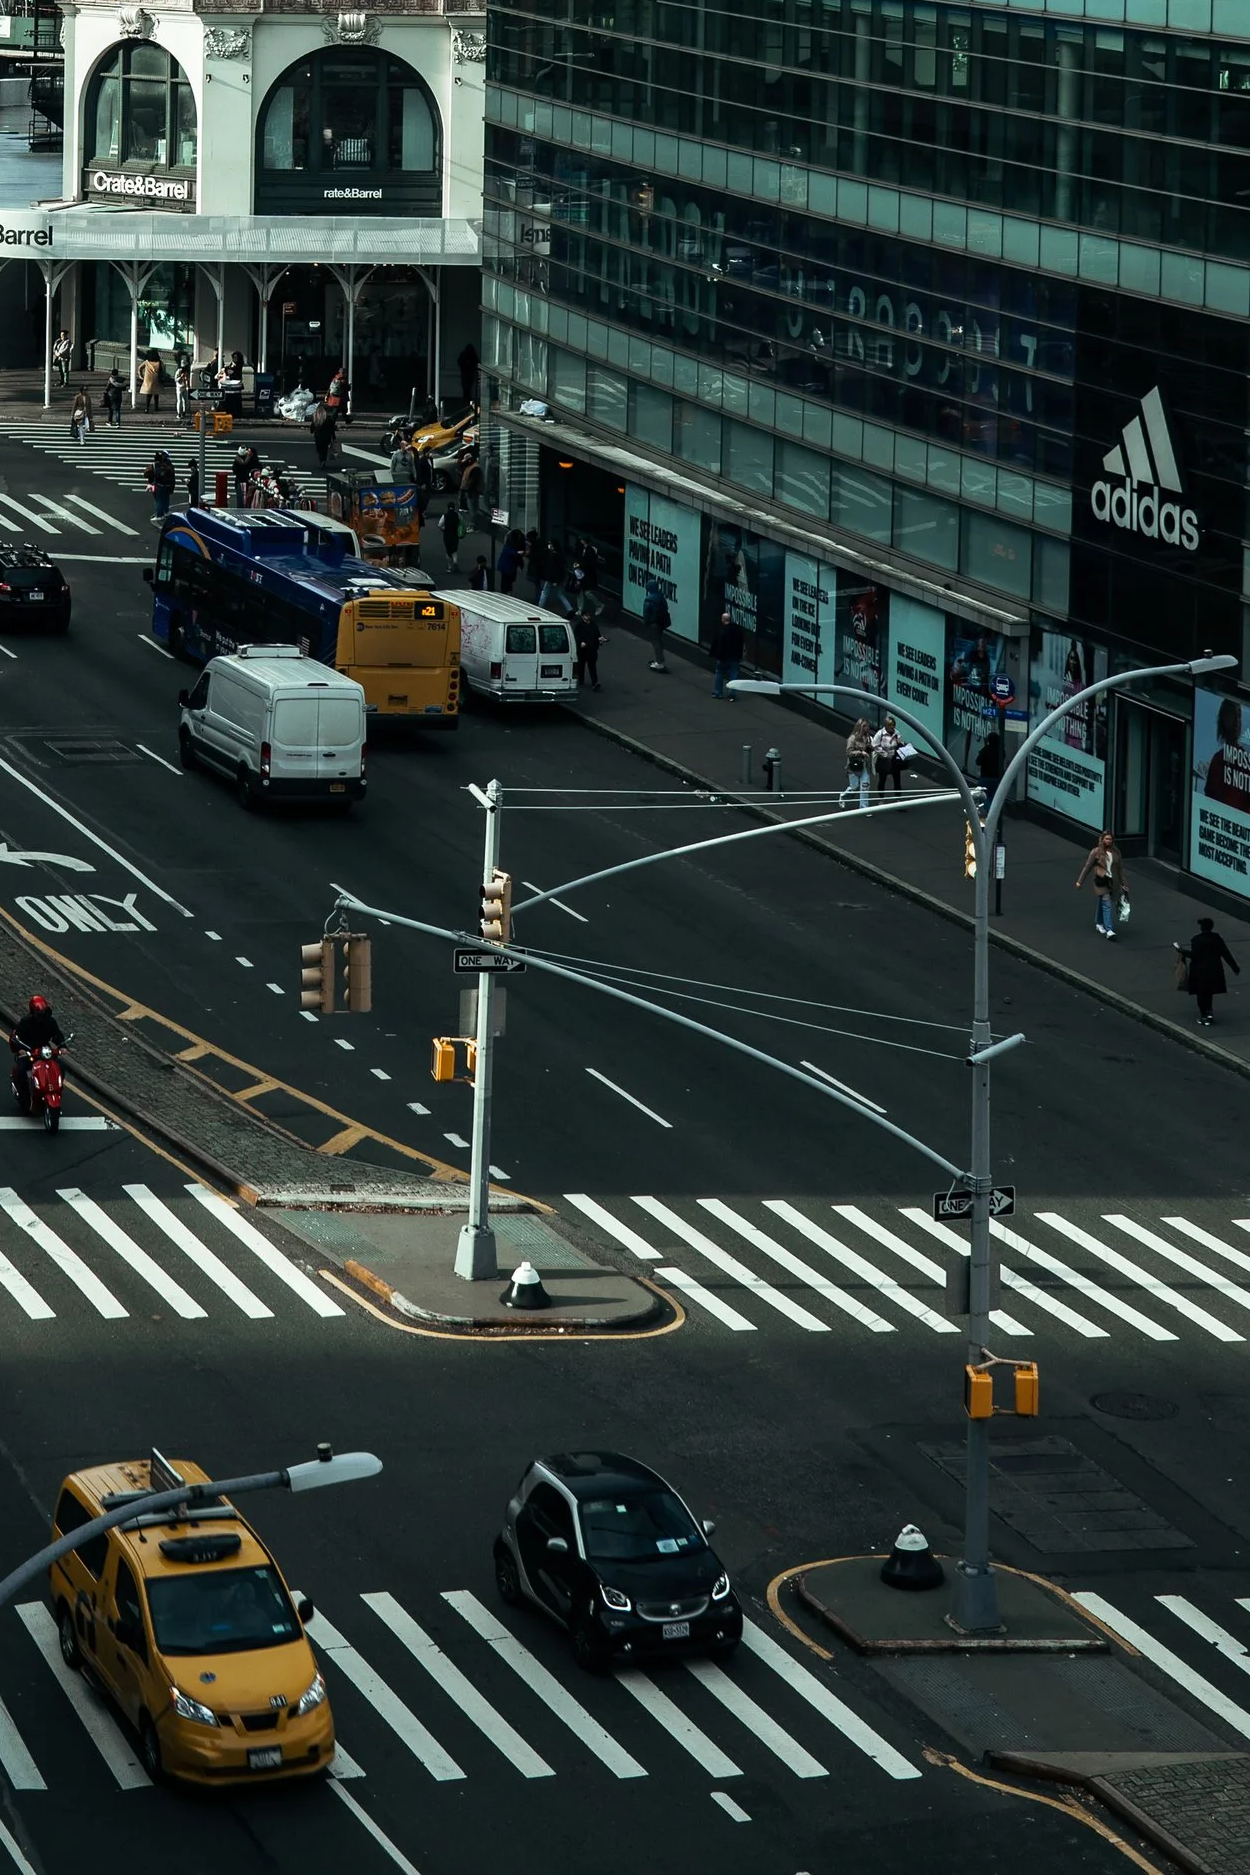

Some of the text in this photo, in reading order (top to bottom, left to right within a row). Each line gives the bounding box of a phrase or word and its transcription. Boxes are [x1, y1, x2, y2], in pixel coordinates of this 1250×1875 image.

[93, 171, 188, 199] Crate&Barrel
[1091, 476, 1200, 551] adidas
[629, 515, 640, 537] WE
[650, 524, 678, 554] LEADERS
[655, 551, 672, 576] PATH
[724, 581, 758, 613] IMPOSSIBLE
[792, 577, 800, 592] WE
[800, 581, 808, 596] SEE
[730, 605, 757, 633] NOTHING
[799, 598, 807, 614] THE
[800, 635, 814, 654] EVERY
[843, 634, 880, 667] IMPOSSIBLE
[897, 641, 937, 671] WE SEE LEADERS
[850, 659, 879, 688] NOTHING
[896, 660, 914, 681] PAVING
[917, 670, 931, 688] PATH
[931, 676, 939, 692] ON
[896, 679, 911, 699] EVERY
[953, 705, 961, 726] IS
[1223, 765, 1232, 786] IS
[1199, 808, 1209, 824] WE
[1209, 811, 1220, 829] SEE
[1220, 816, 1232, 834] THE
[1199, 825, 1215, 844] GAME
[1215, 831, 1239, 852] BECOME
[1199, 841, 1215, 862] MOST
[15, 893, 158, 933] ONLY
[460, 956, 482, 966] ONE
[941, 1199, 966, 1213] ONE
